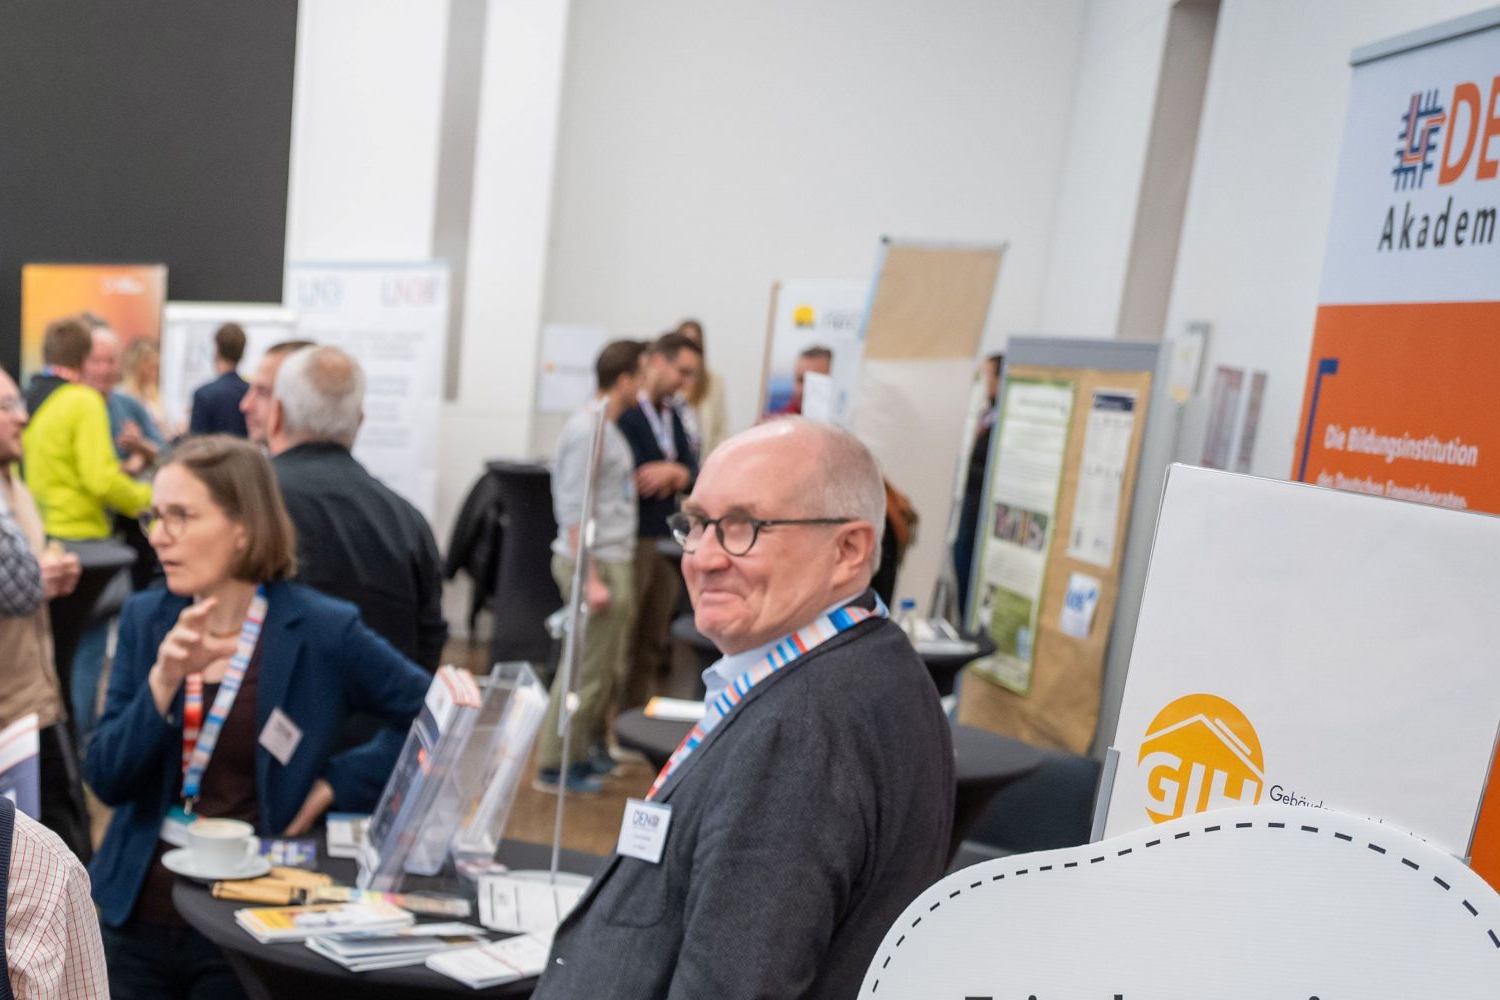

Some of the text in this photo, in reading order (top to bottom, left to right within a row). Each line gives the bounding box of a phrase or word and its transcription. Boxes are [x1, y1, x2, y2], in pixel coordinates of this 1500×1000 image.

[1378, 195, 1497, 251] Akadem
[1324, 423, 1479, 466] Die Bildungsinstitution
